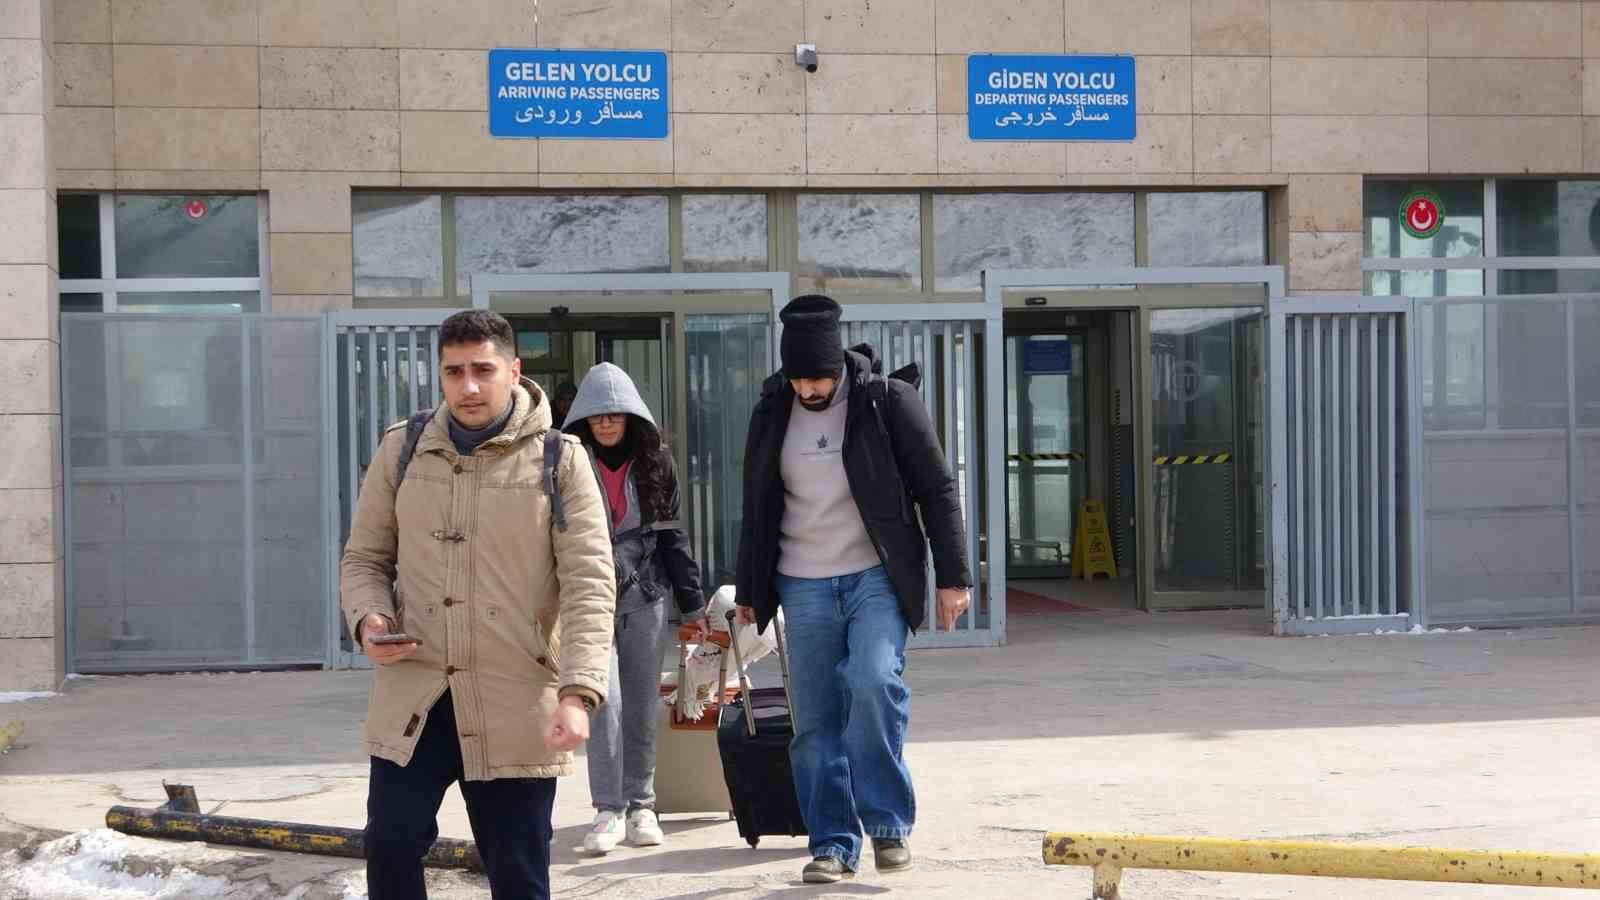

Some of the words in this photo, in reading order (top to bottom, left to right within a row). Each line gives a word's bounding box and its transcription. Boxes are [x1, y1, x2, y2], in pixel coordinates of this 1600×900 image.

[505, 62, 576, 81] GELEN
[581, 63, 652, 82] YOLCU
[1052, 72, 1116, 90] YOLCU
[498, 86, 567, 99] ARRIVING
[570, 87, 660, 100] PASSENGERS
[975, 93, 1046, 105] DEPARTING
[1049, 93, 1129, 106] PASSENGERS
[589, 100, 643, 125] مسافر
[1064, 103, 1110, 126] مسافر
